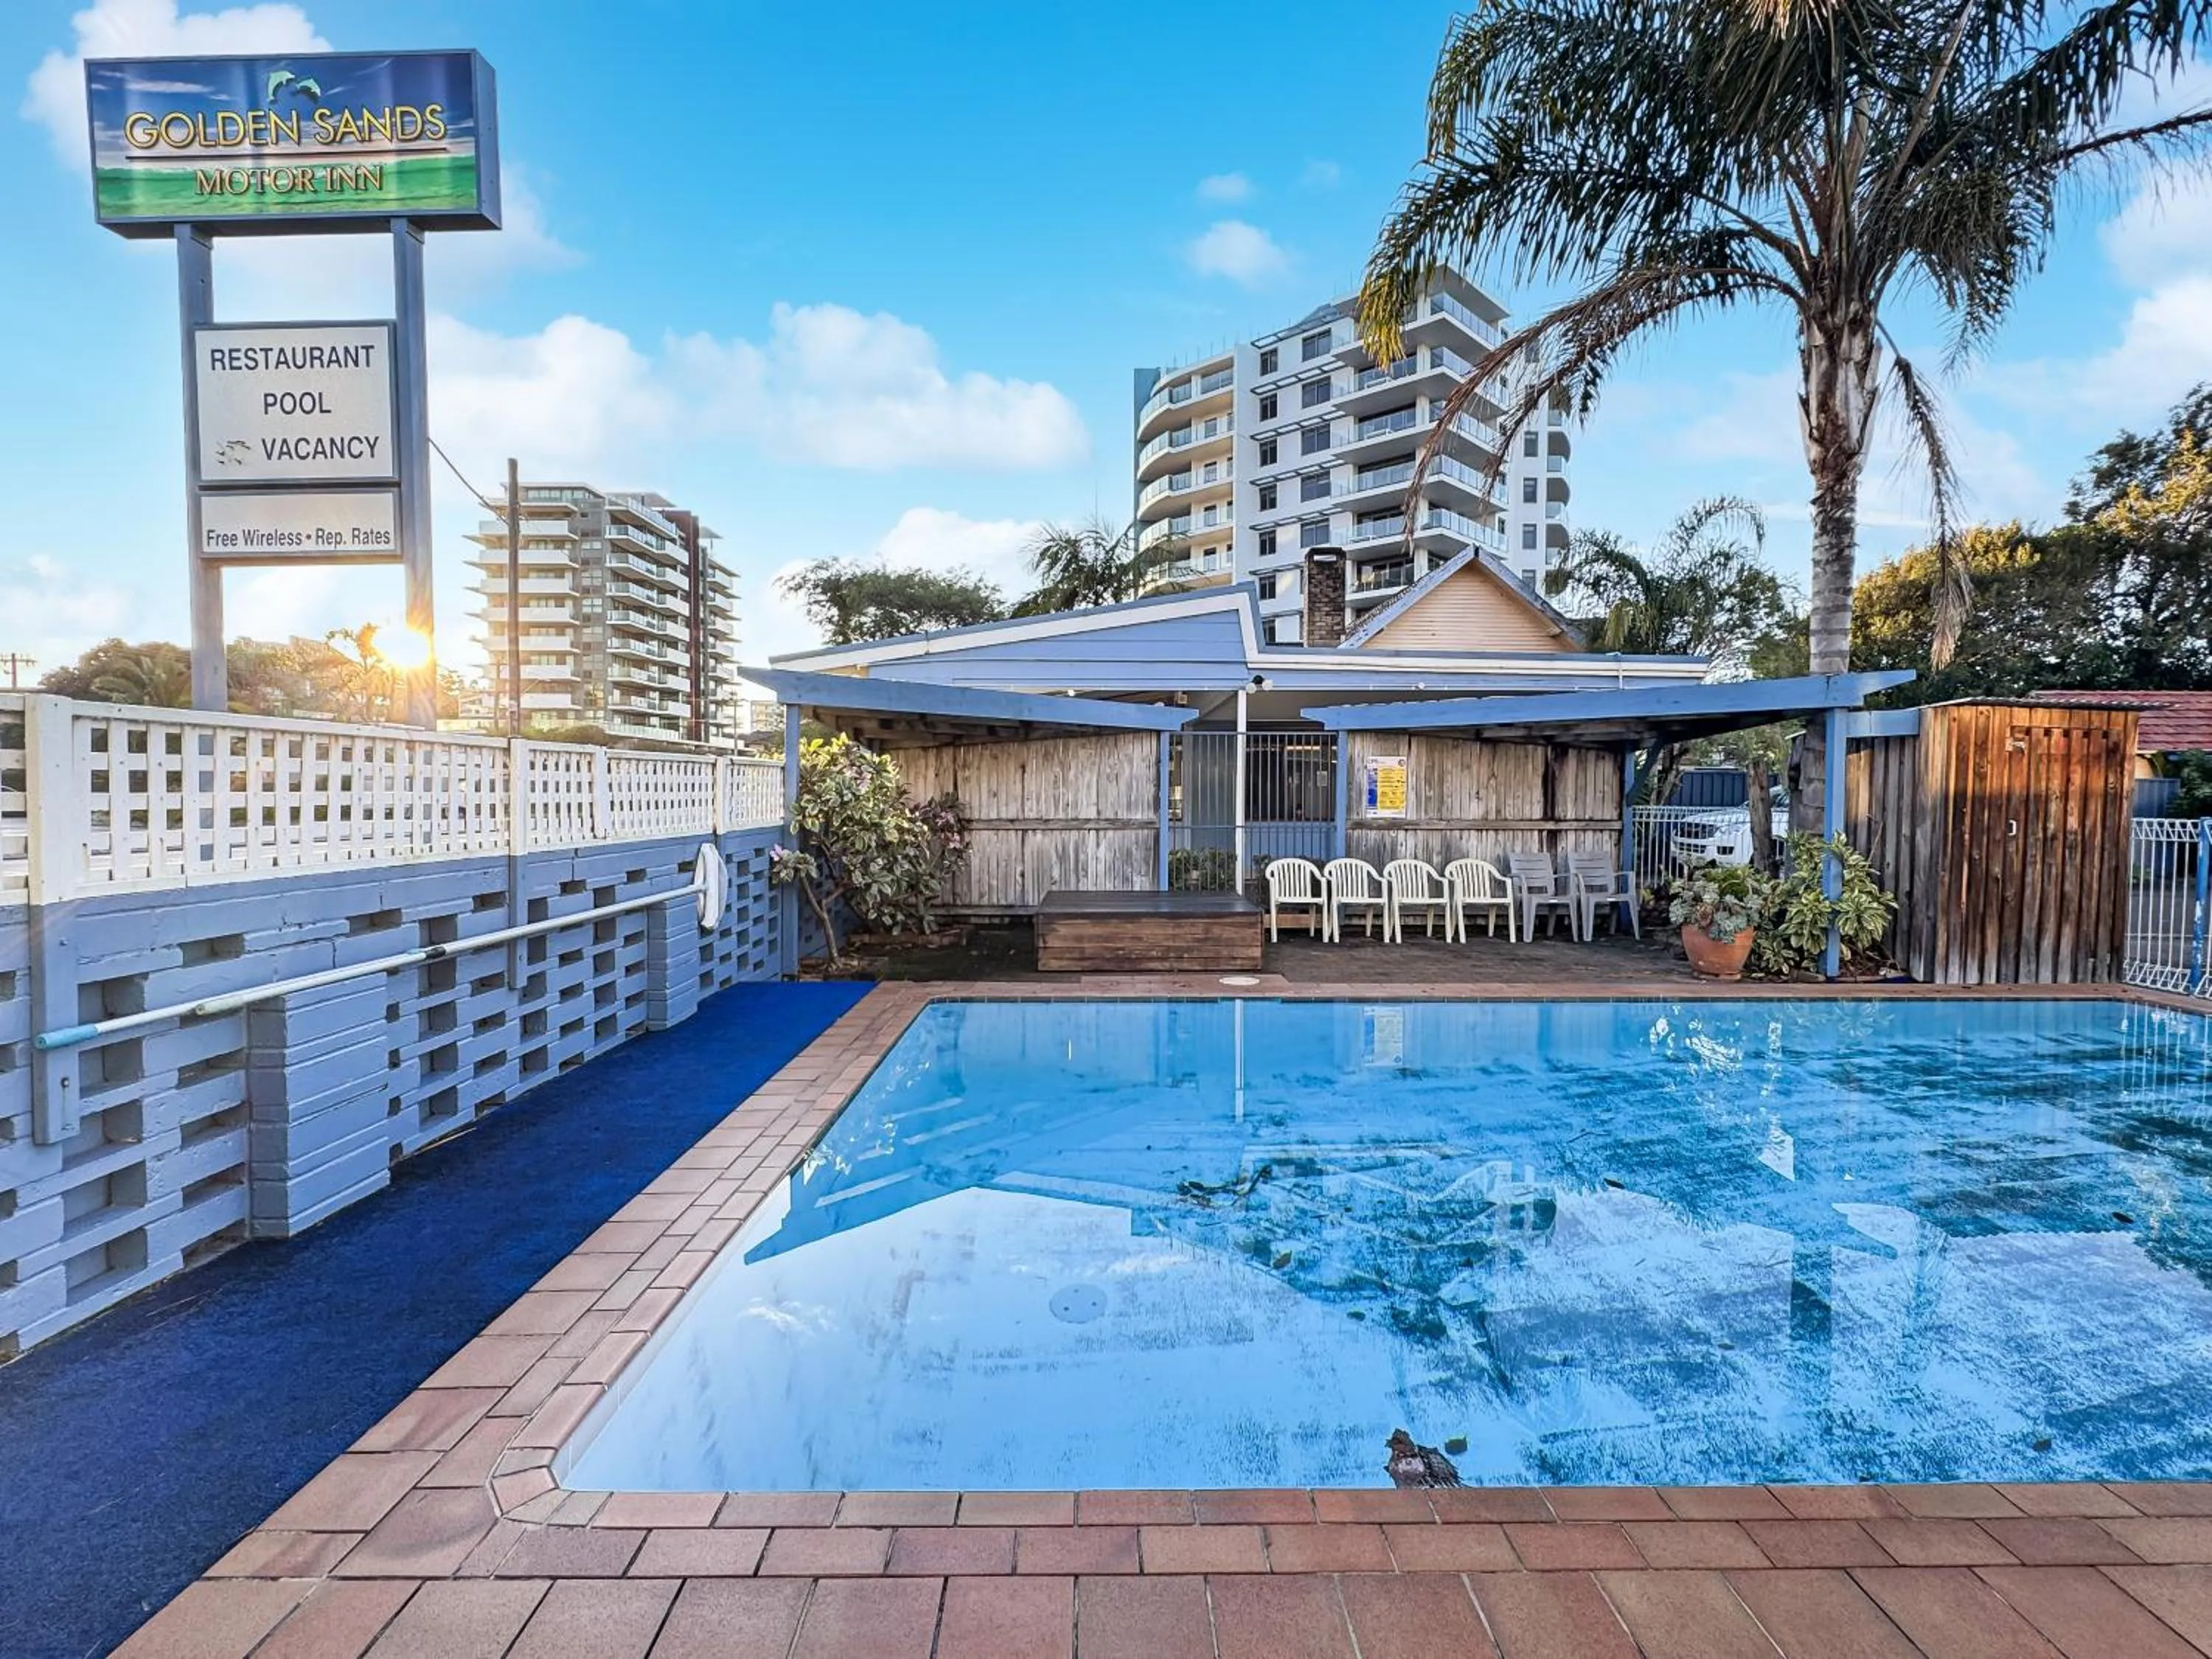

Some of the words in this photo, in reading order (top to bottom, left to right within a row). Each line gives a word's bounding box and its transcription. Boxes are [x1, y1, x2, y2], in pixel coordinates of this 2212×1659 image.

[125, 108, 299, 148] GOLDEN
[314, 104, 447, 144] SANDS
[195, 167, 316, 195] MOTOR
[325, 165, 383, 192] INN
[211, 345, 375, 370] RESTAURANT
[263, 392, 332, 414] POOL
[261, 436, 380, 460] VACANCY
[206, 529, 237, 546] Free
[243, 529, 302, 546] Wireless
[315, 527, 347, 549] Rep.
[352, 527, 391, 544] Rates
